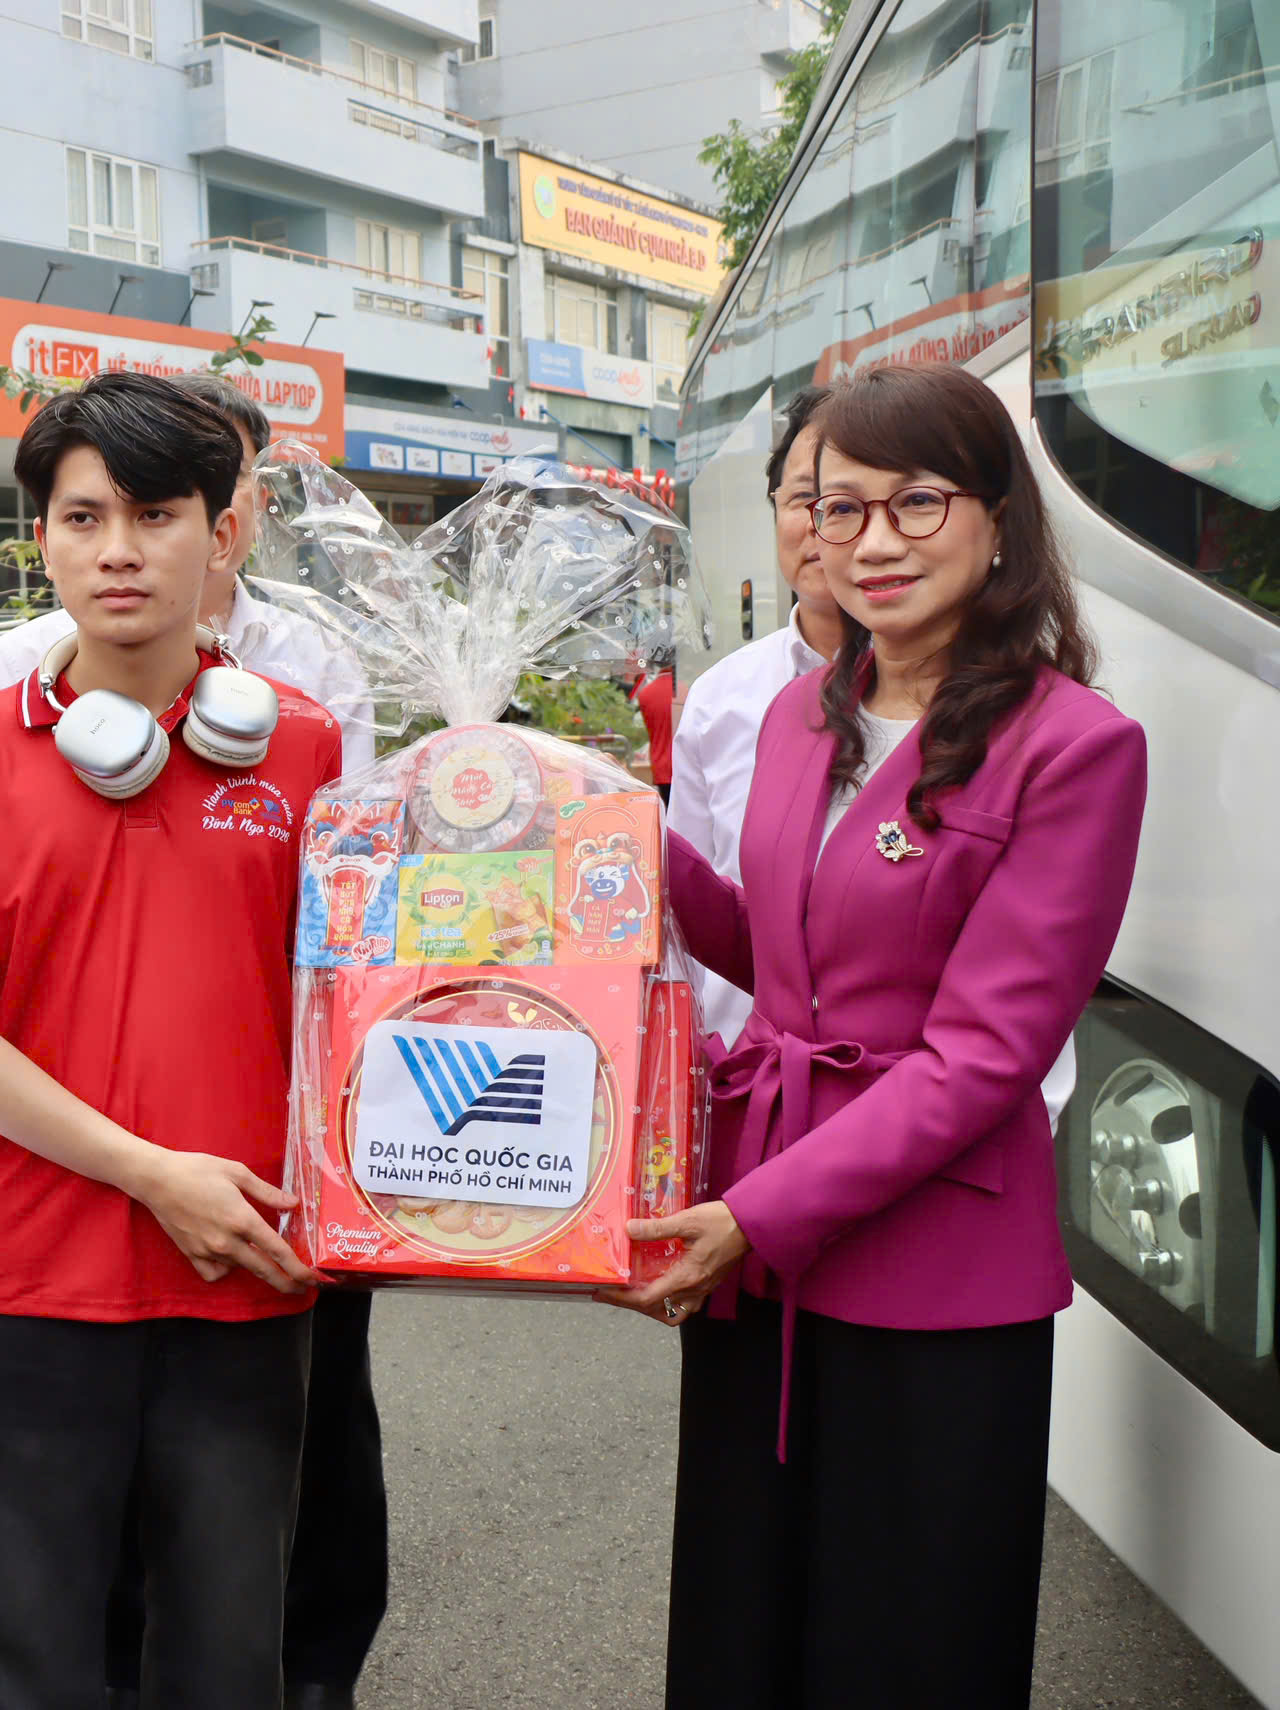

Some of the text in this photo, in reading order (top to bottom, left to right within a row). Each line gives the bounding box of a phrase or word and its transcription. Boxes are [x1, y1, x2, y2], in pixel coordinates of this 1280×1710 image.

[266, 377, 316, 408] LAPTOP
[259, 779, 281, 798] mùa
[424, 893, 460, 906] Lipton
[369, 1141, 573, 1172] ĐẠI HỌC QUỐC GIA
[368, 1164, 572, 1193] THÀNH PHỐ HỒ CHÍ MINH
[326, 1222, 382, 1239] Premium
[336, 1238, 379, 1260] Quality
